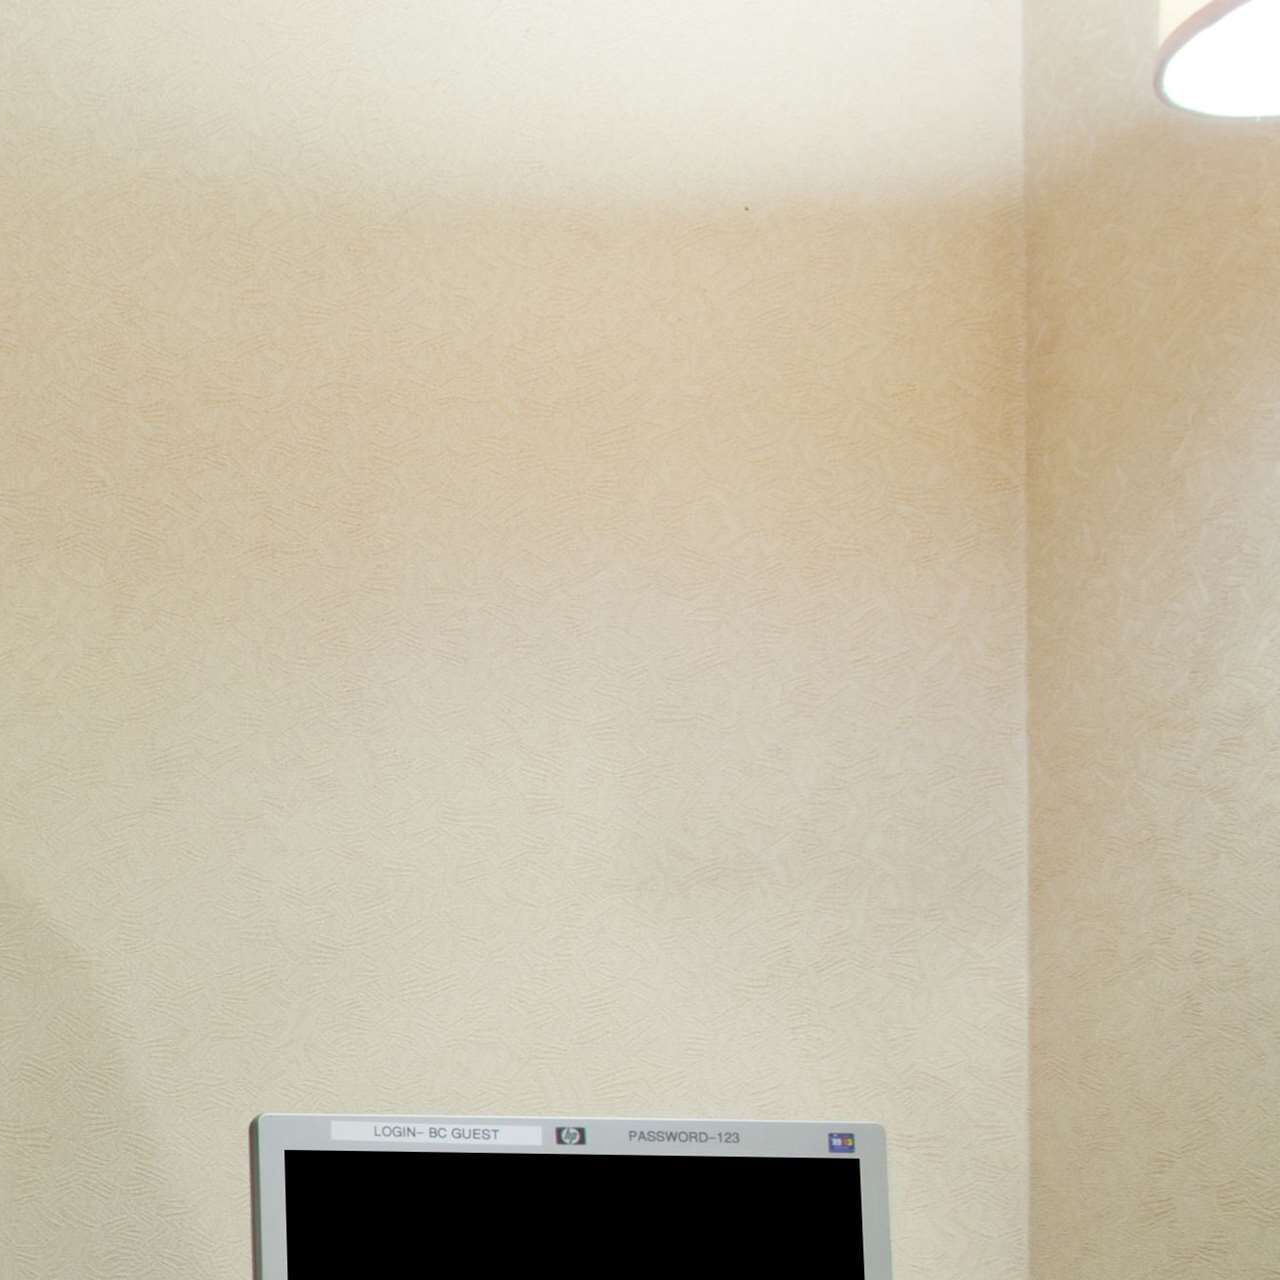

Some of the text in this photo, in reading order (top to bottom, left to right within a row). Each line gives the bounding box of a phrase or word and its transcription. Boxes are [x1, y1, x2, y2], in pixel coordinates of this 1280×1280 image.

[428, 1127, 448, 1140] BC
[451, 1128, 500, 1141] GUEST
[628, 1130, 742, 1143] PASSWORD-123
